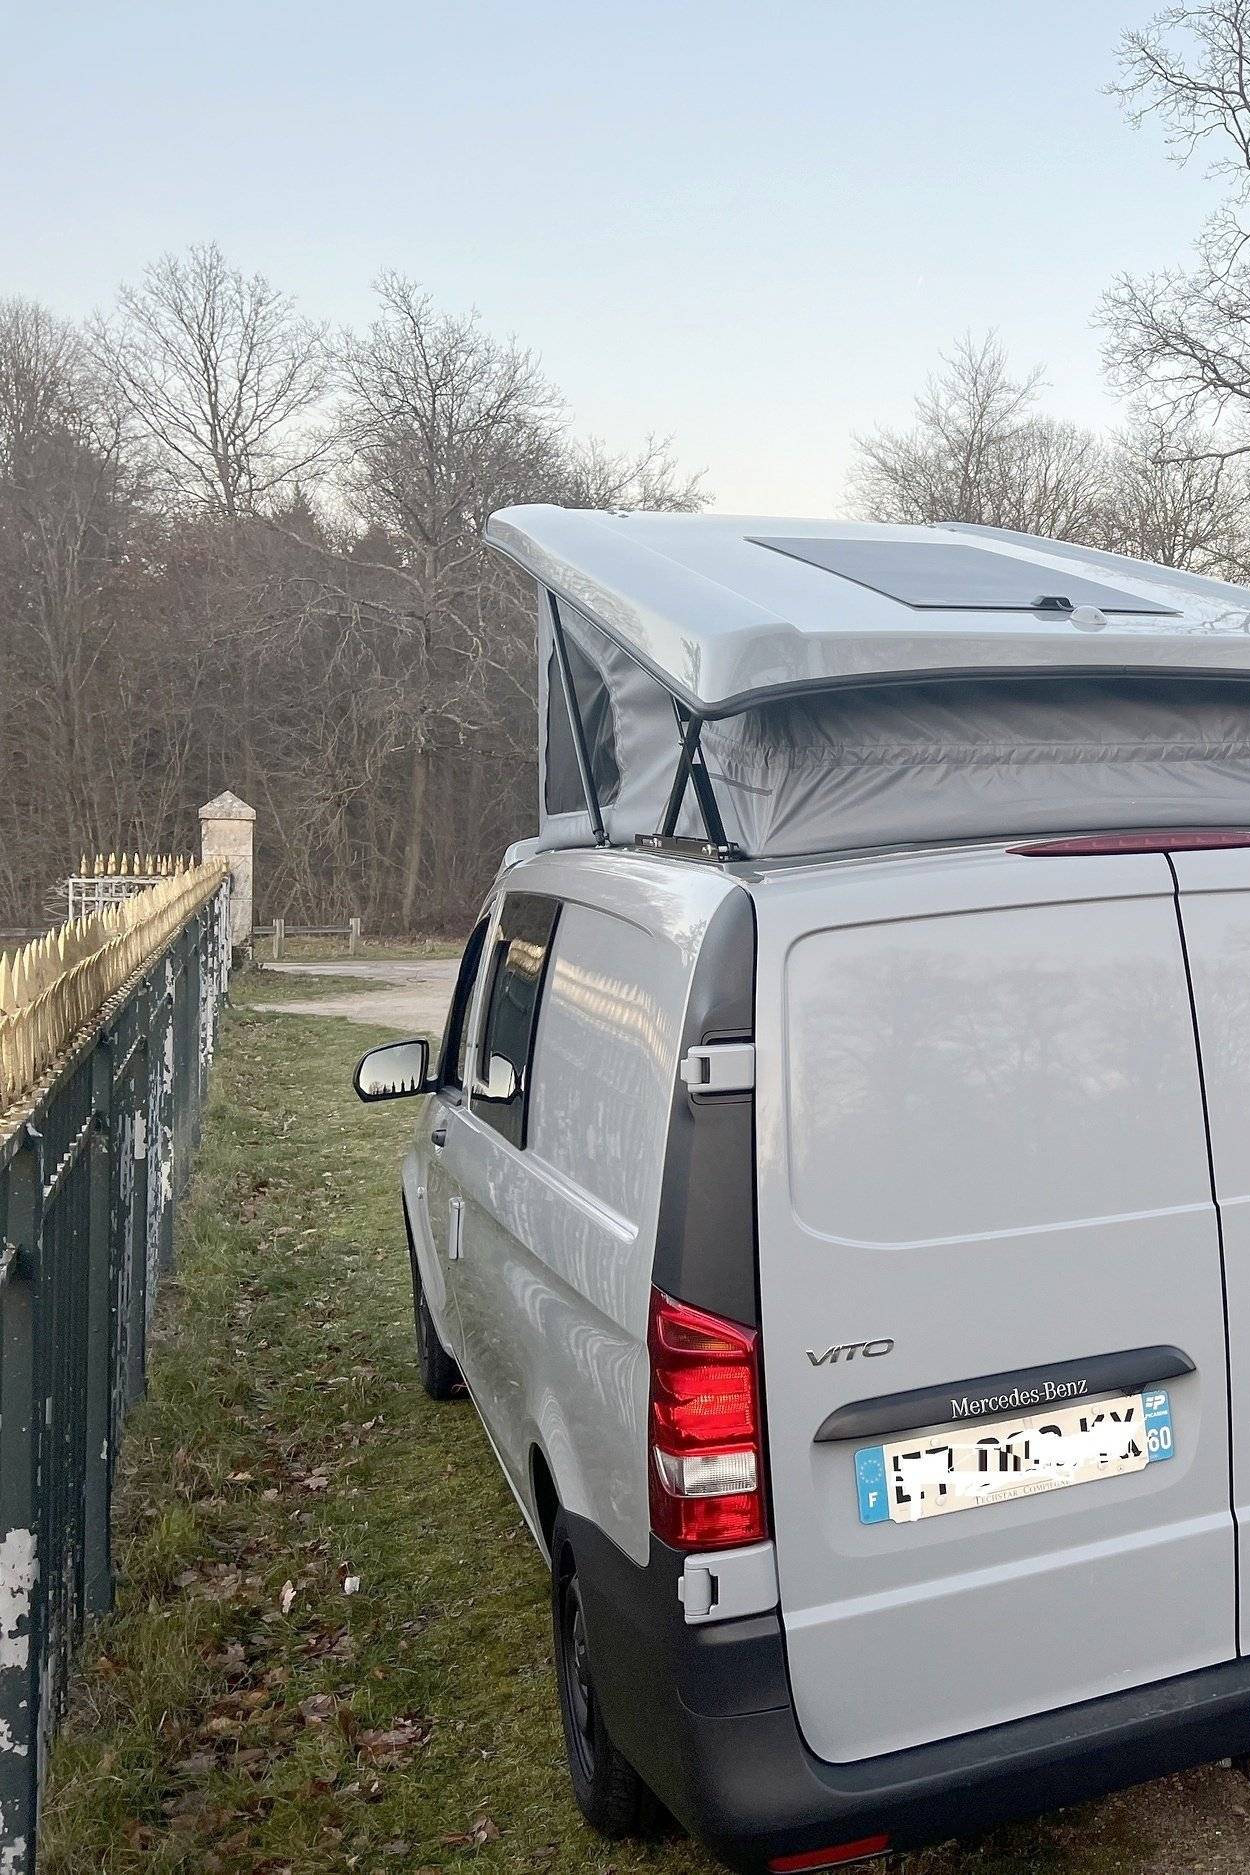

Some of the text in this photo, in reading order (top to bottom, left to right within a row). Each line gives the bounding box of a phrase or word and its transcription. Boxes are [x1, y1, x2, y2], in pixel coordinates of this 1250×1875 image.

[805, 1337, 895, 1366] VITO
[950, 1379, 1088, 1419] Mercedes-Benz
[1147, 1426, 1172, 1452] 60
[868, 1491, 878, 1508] F
